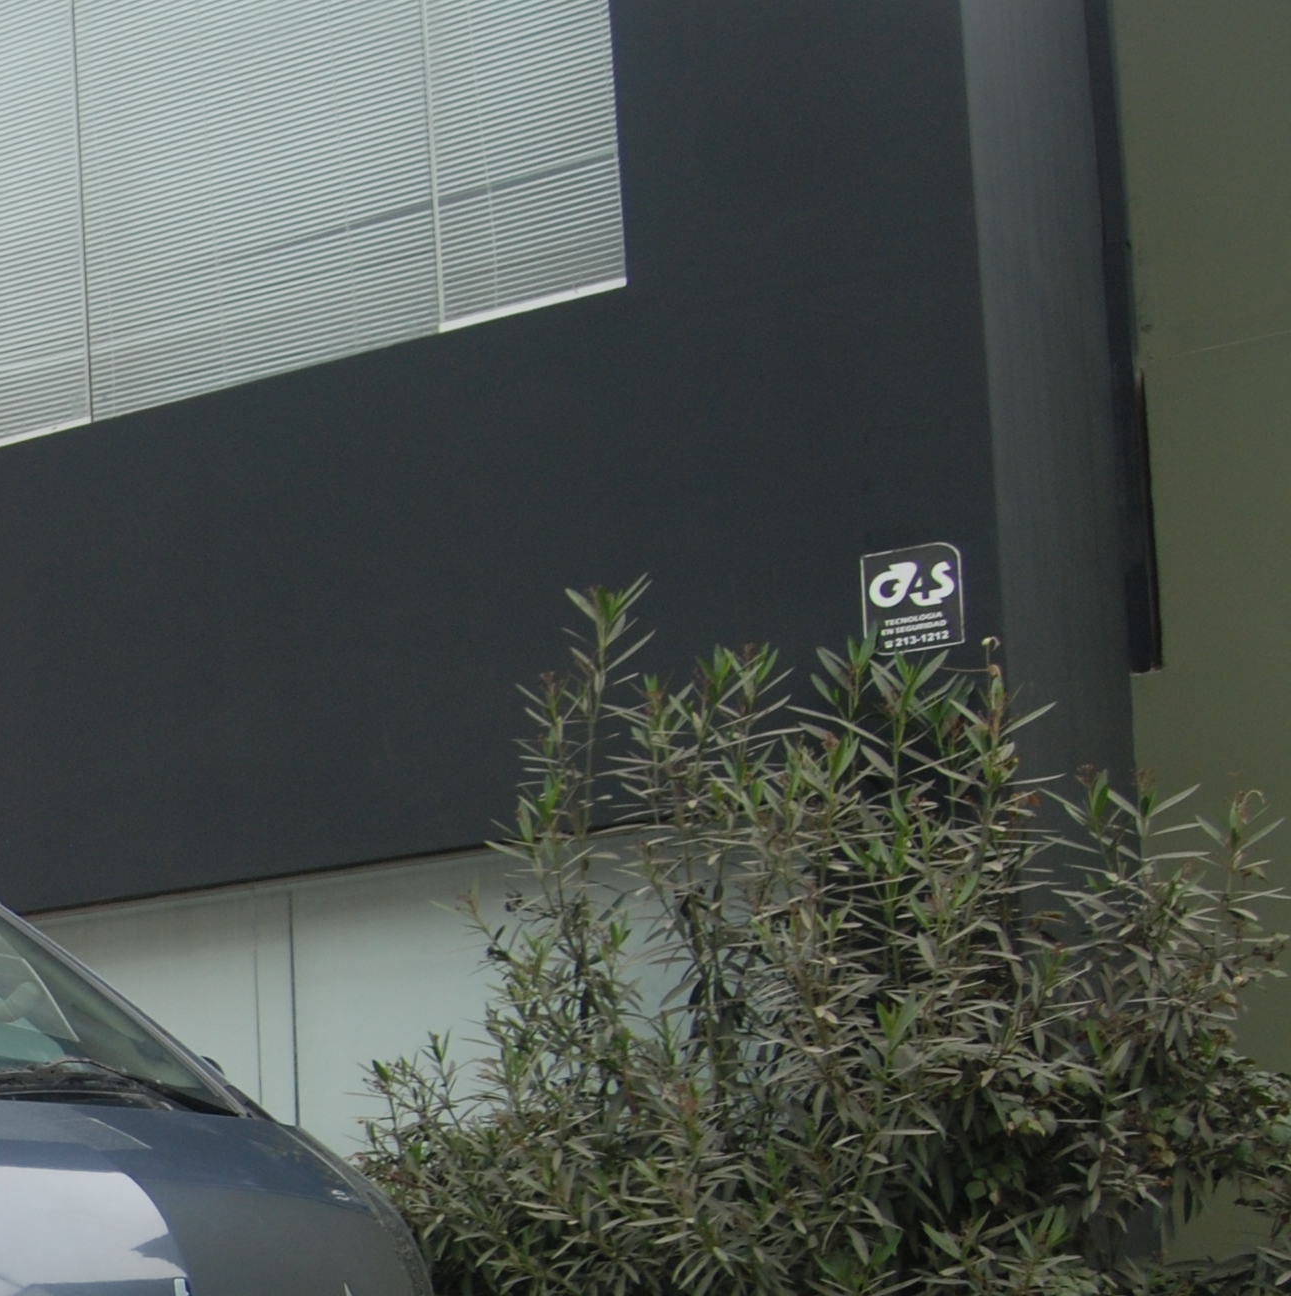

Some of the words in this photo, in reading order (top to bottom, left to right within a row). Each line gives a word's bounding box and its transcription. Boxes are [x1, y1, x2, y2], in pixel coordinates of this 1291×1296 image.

[868, 561, 955, 607] G4S
[880, 628, 894, 636] EN
[895, 630, 949, 647] 213-1212
